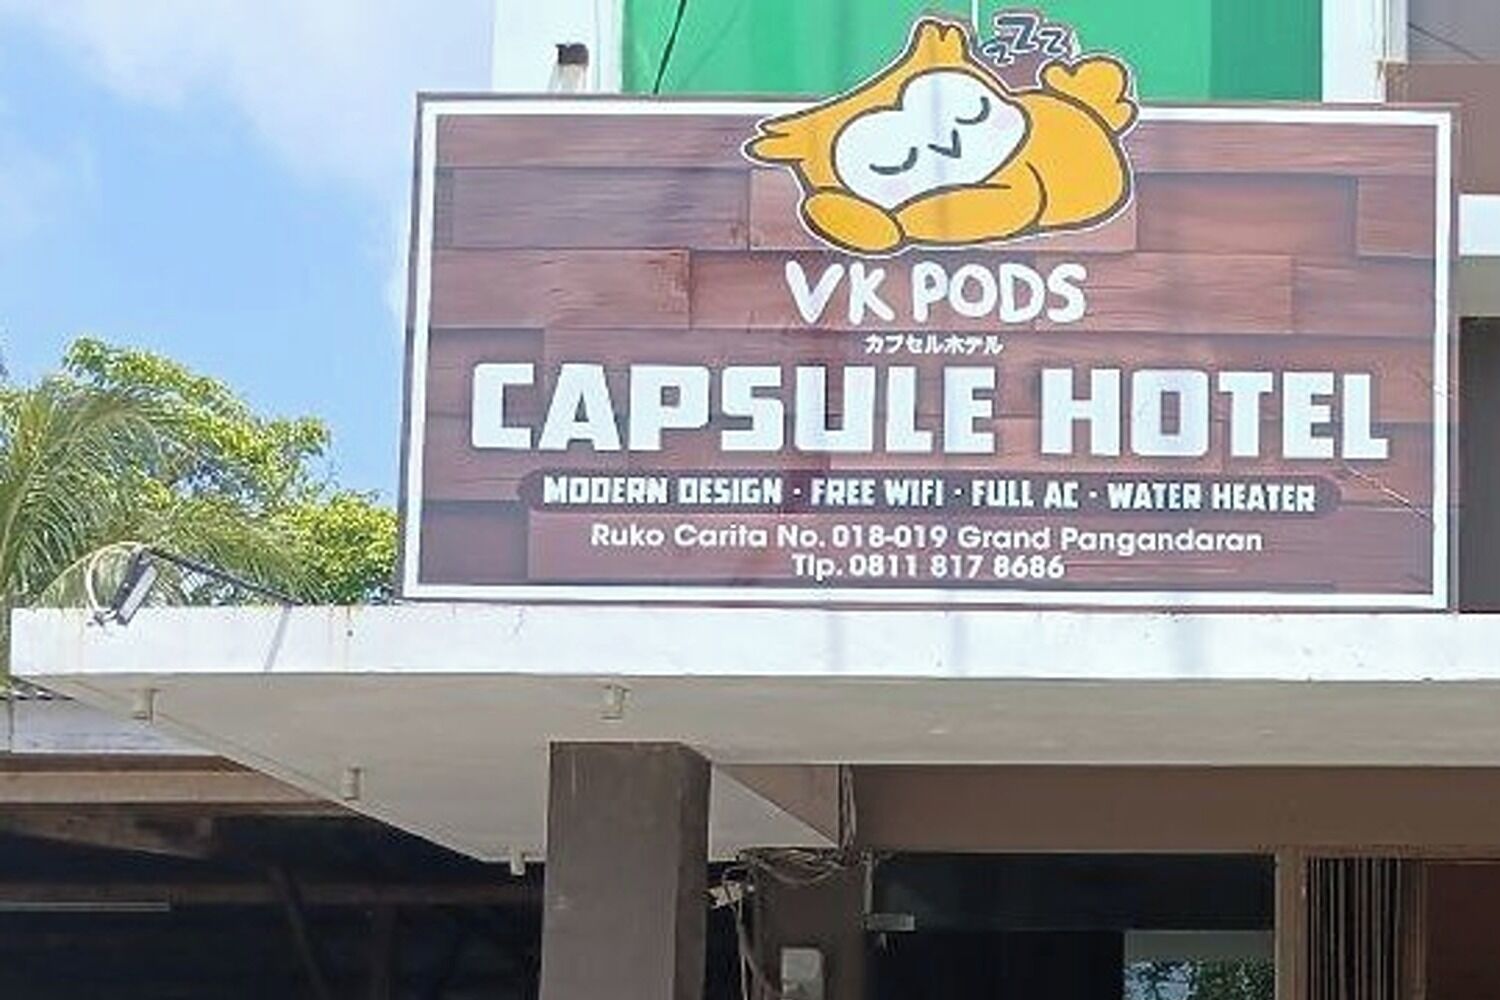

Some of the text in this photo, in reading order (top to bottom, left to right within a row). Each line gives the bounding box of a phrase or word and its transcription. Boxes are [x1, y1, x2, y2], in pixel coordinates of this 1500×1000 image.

[785, 261, 1088, 325] VK PODS
[471, 363, 1389, 459] CAPSULE HOTEL
[543, 476, 1316, 513] MODERN DESIGN FREE WIFI FULL AC WATER HEATER
[590, 524, 1263, 557] Ruko Carita No. 018-019 Grand Pangandaran
[849, 554, 919, 577] 0811
[929, 555, 982, 579] 817
[993, 556, 1065, 580] 8686
